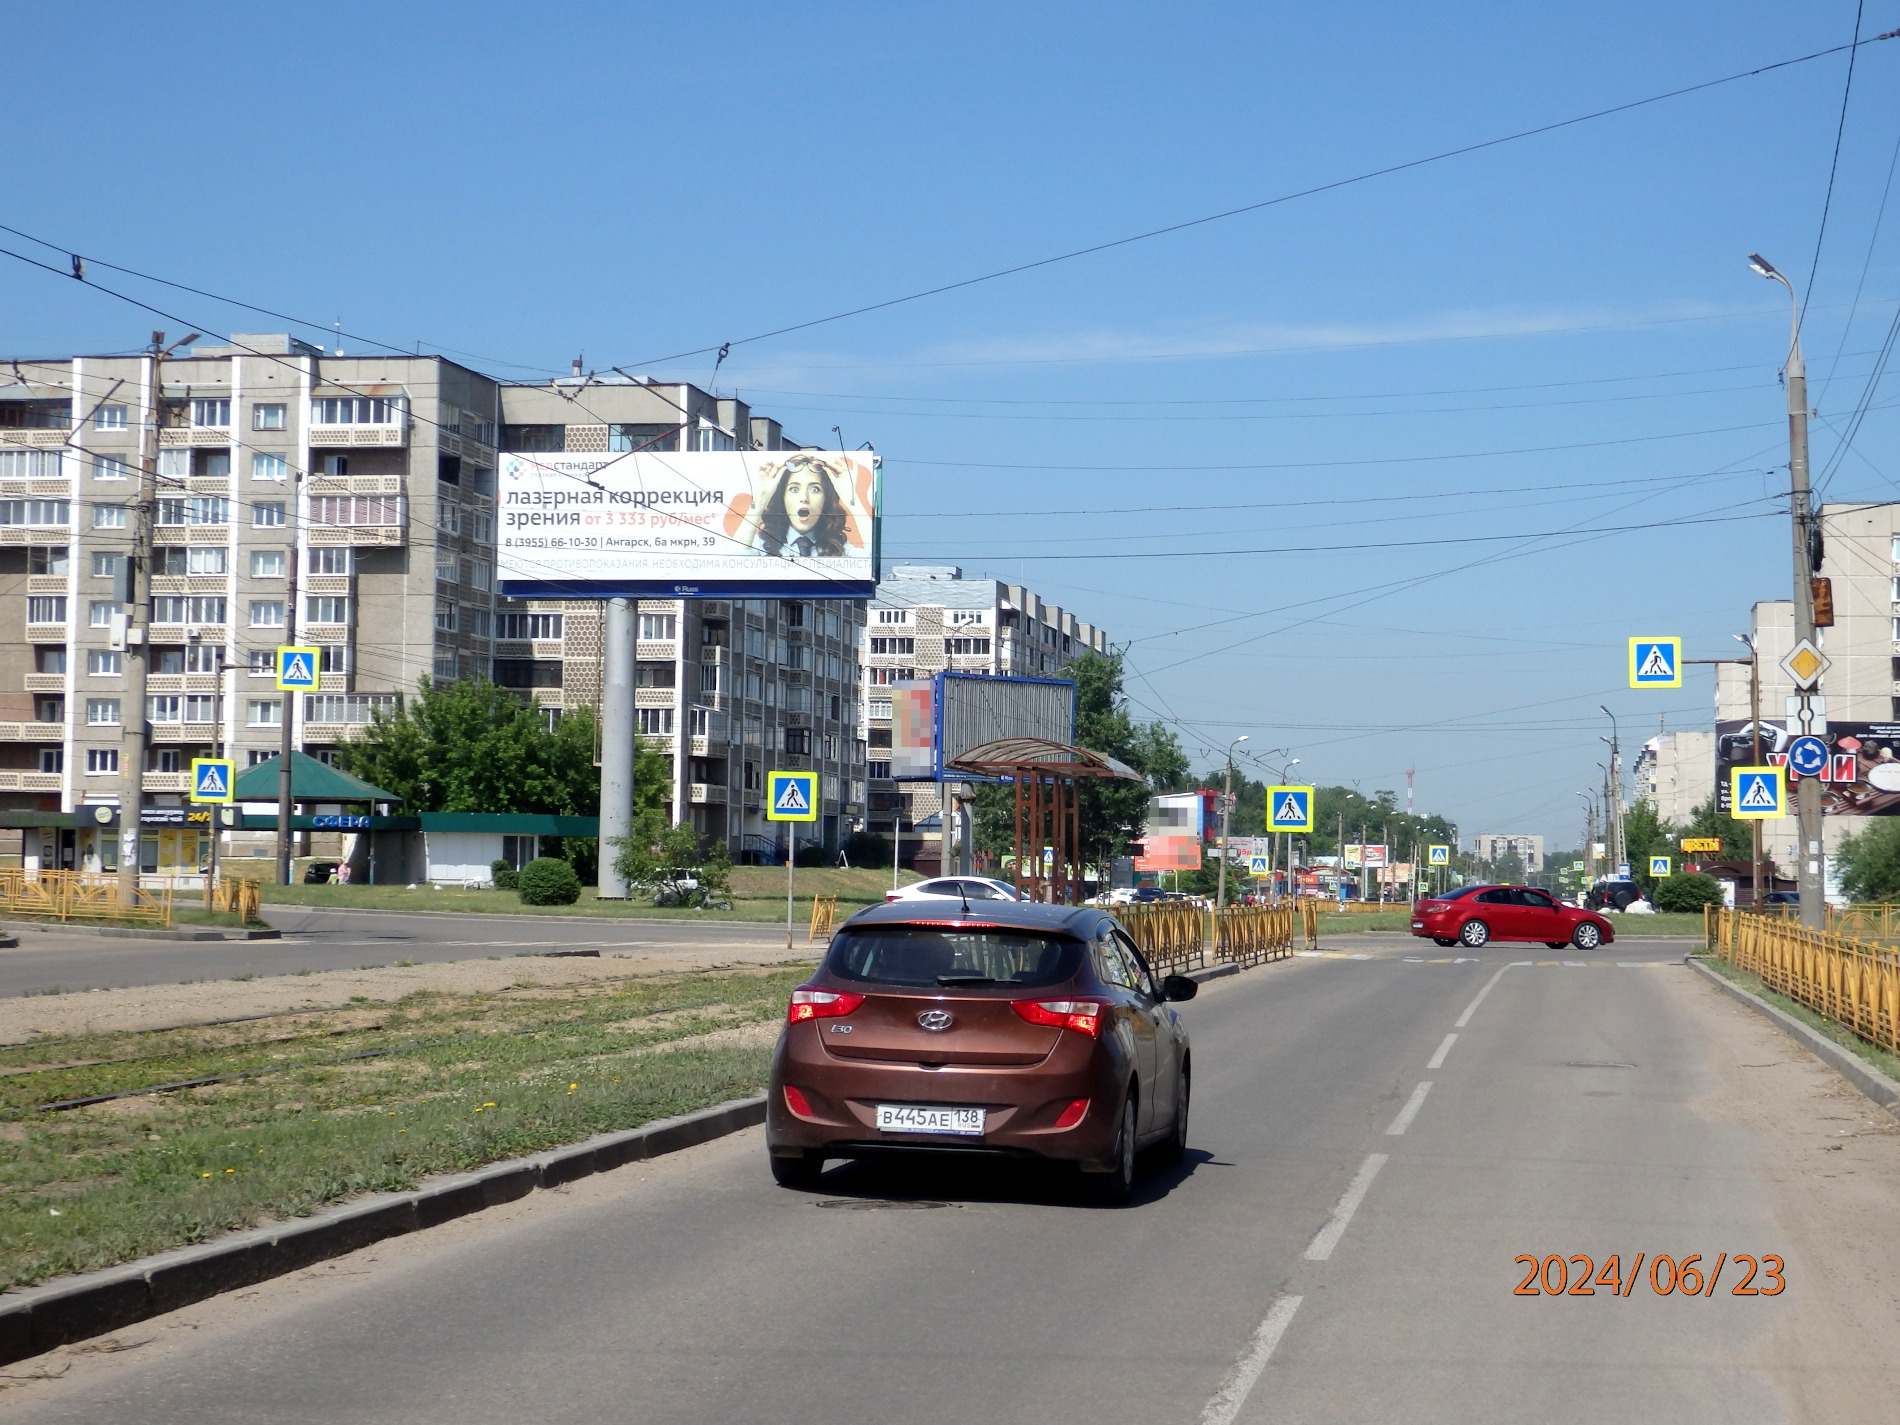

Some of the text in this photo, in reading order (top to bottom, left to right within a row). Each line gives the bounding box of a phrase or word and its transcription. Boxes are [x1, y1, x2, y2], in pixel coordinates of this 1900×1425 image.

[506, 490, 723, 509] лазерная коррекция
[506, 513, 581, 530] зрения
[585, 514, 601, 525] от
[505, 538, 512, 547] 8
[515, 537, 548, 548] (3955)
[551, 537, 597, 547] 66-10-30
[605, 537, 652, 548] Ангарск,
[670, 538, 700, 548] мкрн,
[702, 537, 715, 547] 39
[652, 558, 720, 570] НЕОБХОДИМА
[723, 558, 799, 570] КОНСУЛЬТАЦИЯ
[313, 815, 370, 828] СФЕРА
